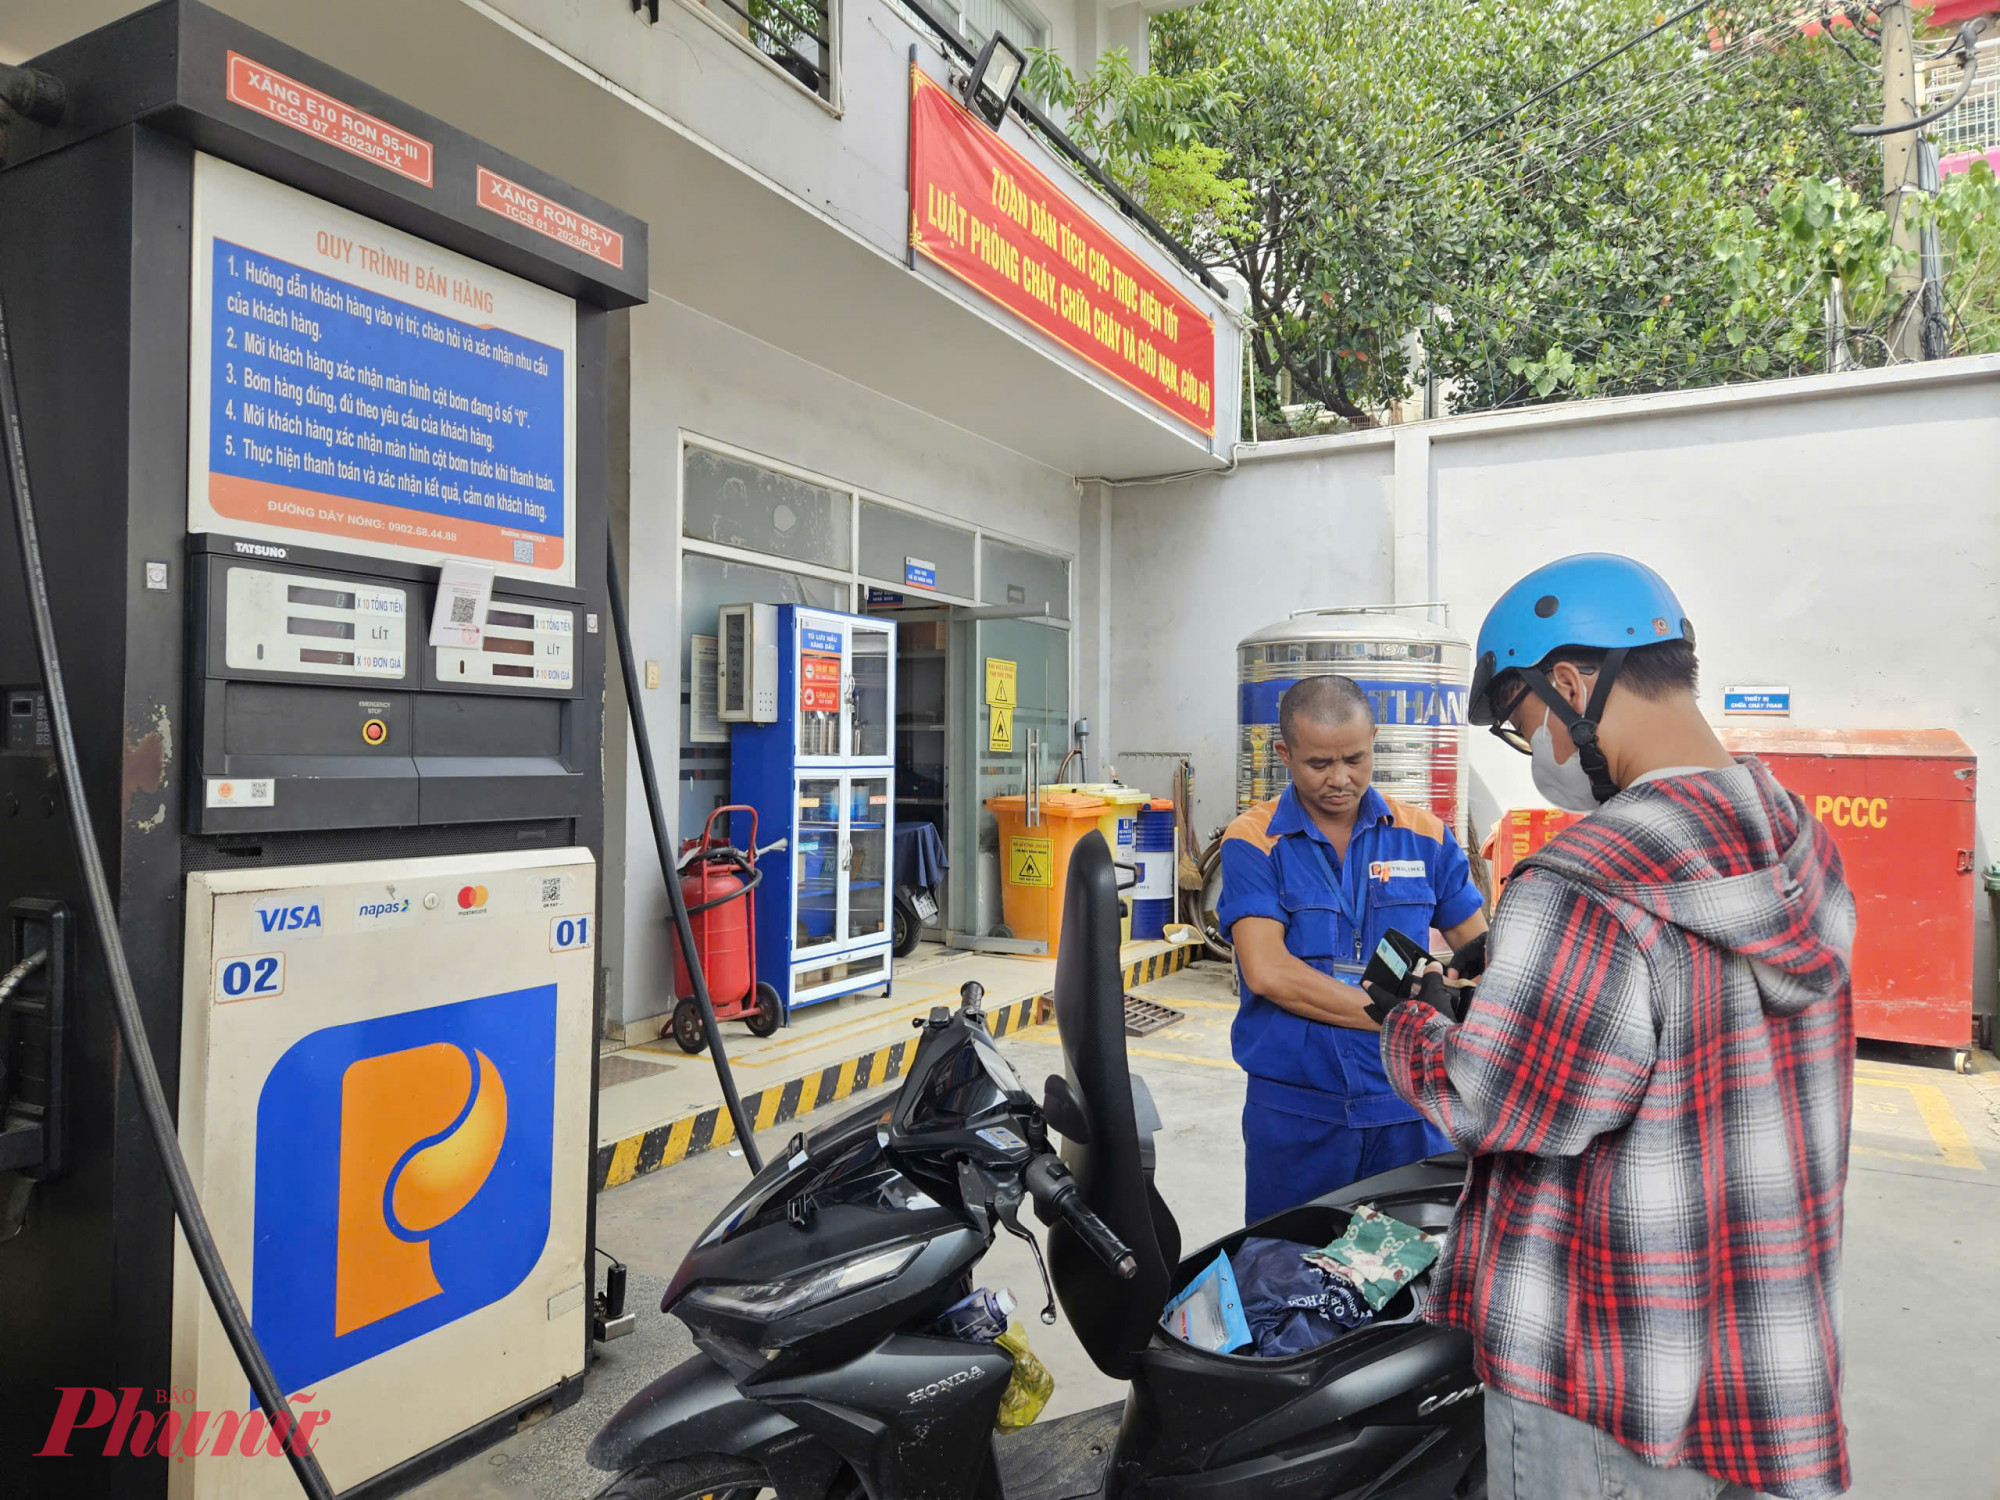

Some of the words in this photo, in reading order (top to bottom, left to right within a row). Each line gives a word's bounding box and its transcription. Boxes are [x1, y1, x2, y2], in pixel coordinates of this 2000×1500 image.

[248, 71, 300, 106] XĂNG
[306, 98, 337, 122] E10
[342, 113, 377, 141] RON
[382, 133, 418, 160] 95-III
[266, 98, 308, 126] TCCS
[312, 118, 328, 134] 07
[341, 131, 402, 168] 2023/PLX
[491, 180, 538, 213] XĂNG
[543, 205, 577, 232] RON
[581, 223, 612, 247] 95-V
[504, 203, 533, 225] TCCS
[536, 220, 548, 232] 01
[557, 228, 601, 255] 2023/PLX
[316, 230, 353, 264] QUY
[359, 245, 409, 285] TRÌNH
[415, 266, 447, 298] BÁN
[452, 279, 494, 314] HÀNG
[992, 166, 1028, 229] TOÀN
[1031, 200, 1057, 252] DÂN
[1060, 222, 1086, 273] TÍCH
[1089, 247, 1110, 292] CỰC
[1113, 266, 1138, 314] THỰC
[1140, 287, 1161, 332] HIỆN
[1164, 303, 1179, 343] TỐT
[227, 255, 239, 277] 1.
[245, 260, 284, 297] Hướng
[287, 272, 308, 300] dẫn
[311, 282, 343, 311] khách
[346, 294, 372, 325] hàng
[375, 305, 392, 327] vào
[395, 312, 404, 335] vị
[422, 321, 444, 345] chào
[447, 327, 460, 348] hỏi
[463, 333, 473, 352] và
[475, 339, 491, 358] xác
[493, 344, 514, 368] nhận
[516, 352, 532, 371] nhu
[227, 291, 249, 316] của
[253, 298, 288, 328] khách
[291, 310, 322, 342] hàng.
[928, 182, 967, 249] LUẬT
[971, 215, 1019, 285] PHÒNG
[1023, 255, 1057, 315] CHÁY,
[1061, 283, 1091, 335] CHỮA
[1094, 307, 1121, 354] CHÁY
[1123, 326, 1136, 365] VÀ
[1138, 338, 1157, 378] CỨU
[1181, 368, 1197, 405] CỨU
[1199, 380, 1210, 418] HỘ
[226, 326, 238, 349] 2.
[244, 331, 265, 357] Mời
[268, 338, 304, 368] khách
[306, 349, 334, 380] hàng
[336, 360, 355, 381] xác
[358, 366, 383, 392] nhận
[386, 374, 407, 396] màn
[409, 378, 431, 402] hình
[433, 387, 447, 410] cột
[449, 389, 469, 413] bơm
[471, 396, 493, 423] đang
[502, 405, 513, 424] số
[226, 362, 237, 385] 3.
[244, 367, 271, 394] Bơm
[274, 375, 303, 406] hàng
[306, 384, 337, 414] đúng,
[339, 393, 353, 414] đủ
[356, 397, 379, 420] theo
[380, 404, 399, 427] yêu
[421, 413, 438, 434] của
[440, 418, 468, 443] khách
[470, 426, 495, 453] hàng.
[225, 399, 237, 421] 4.
[243, 403, 264, 427] Mời
[267, 408, 302, 436] khách
[305, 417, 333, 447] hàng
[335, 426, 354, 448] xác
[357, 431, 383, 457] nhận
[385, 438, 406, 459] màn
[409, 442, 430, 465] hình
[432, 449, 447, 472] cột
[449, 456, 469, 473] bơm
[471, 458, 493, 479] trước
[495, 462, 508, 482] khi
[510, 466, 534, 488] thanh
[536, 474, 556, 493] toán.
[225, 434, 236, 457] 5.
[243, 438, 273, 468] Thực
[275, 445, 300, 473] hiện
[304, 451, 335, 477] thanh
[338, 459, 360, 482] toán
[363, 465, 375, 485] và
[377, 466, 396, 487] xác
[398, 472, 422, 497] nhận
[425, 476, 439, 498] kết
[441, 482, 461, 505] quả,
[463, 484, 483, 507] cảm
[484, 493, 495, 509] ơn
[497, 492, 523, 515] khách
[524, 498, 547, 523] hàng.
[267, 500, 315, 518] ĐƯỜNG
[319, 508, 344, 523] DÂY
[347, 513, 386, 530] NÓNG:
[235, 542, 286, 559] TATSUNO
[363, 599, 370, 610] 10
[372, 626, 389, 640] LÍT
[547, 644, 560, 655] LÍT
[364, 657, 371, 666] 10
[1368, 682, 1469, 724] THÀN
[1815, 795, 1888, 829] PCCC
[254, 905, 321, 932] VISA
[359, 902, 400, 918] napas
[458, 908, 487, 916] mastercard
[556, 918, 587, 946] 01
[223, 957, 278, 996] 02
[906, 1365, 986, 1405] HONDA
